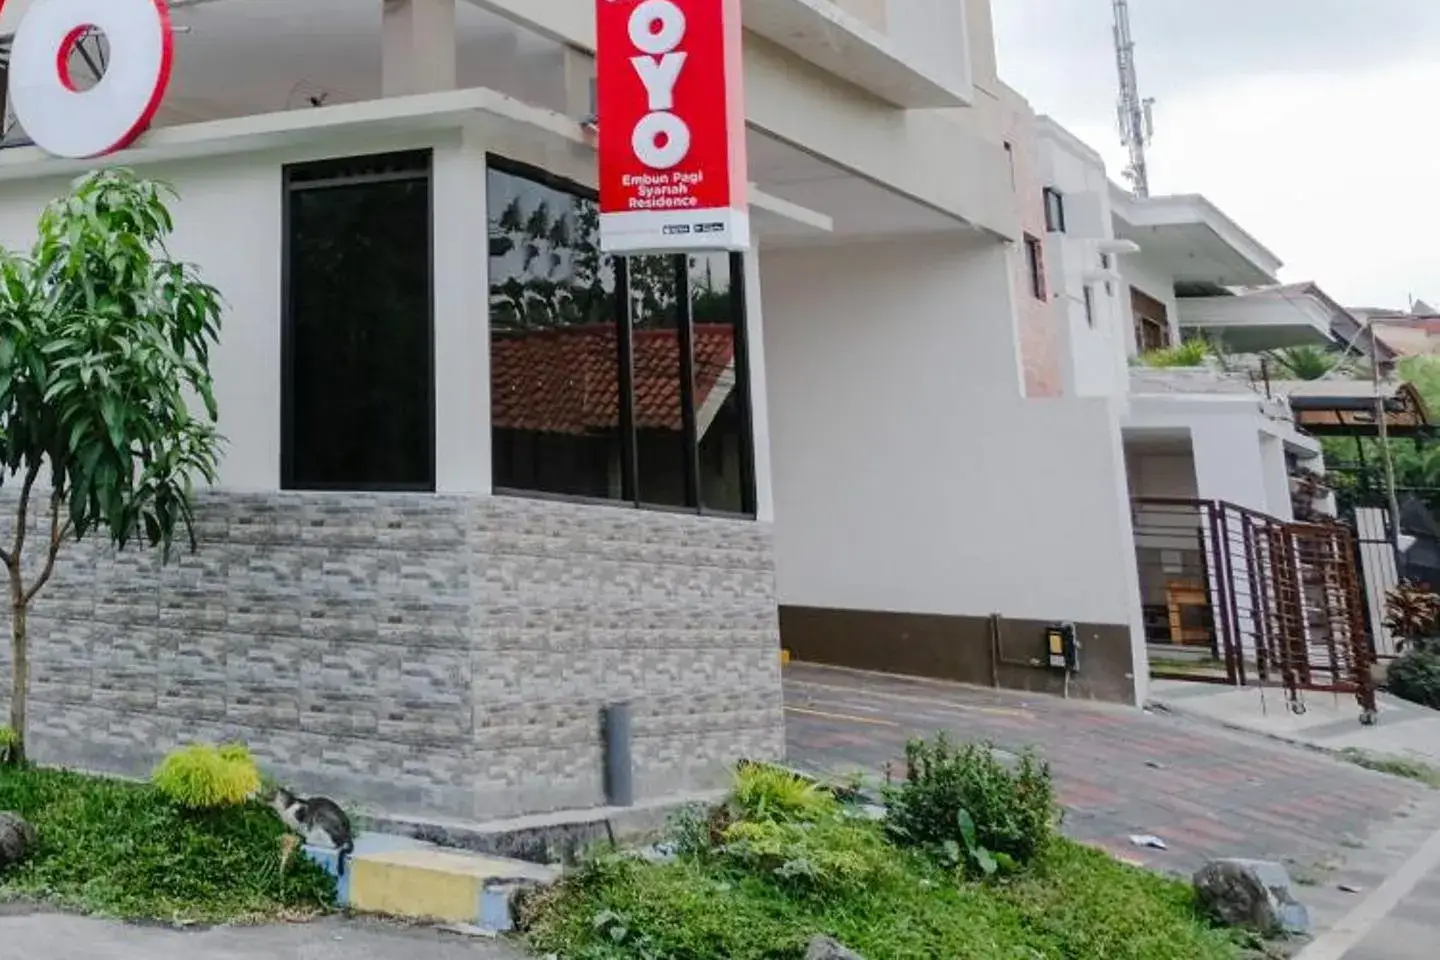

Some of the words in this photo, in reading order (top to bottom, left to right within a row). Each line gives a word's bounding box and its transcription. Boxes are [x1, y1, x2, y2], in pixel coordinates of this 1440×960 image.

[621, 171, 669, 187] Embun
[672, 169, 704, 184] Pagi
[637, 183, 688, 197] Syariah
[627, 196, 699, 209] Residence
